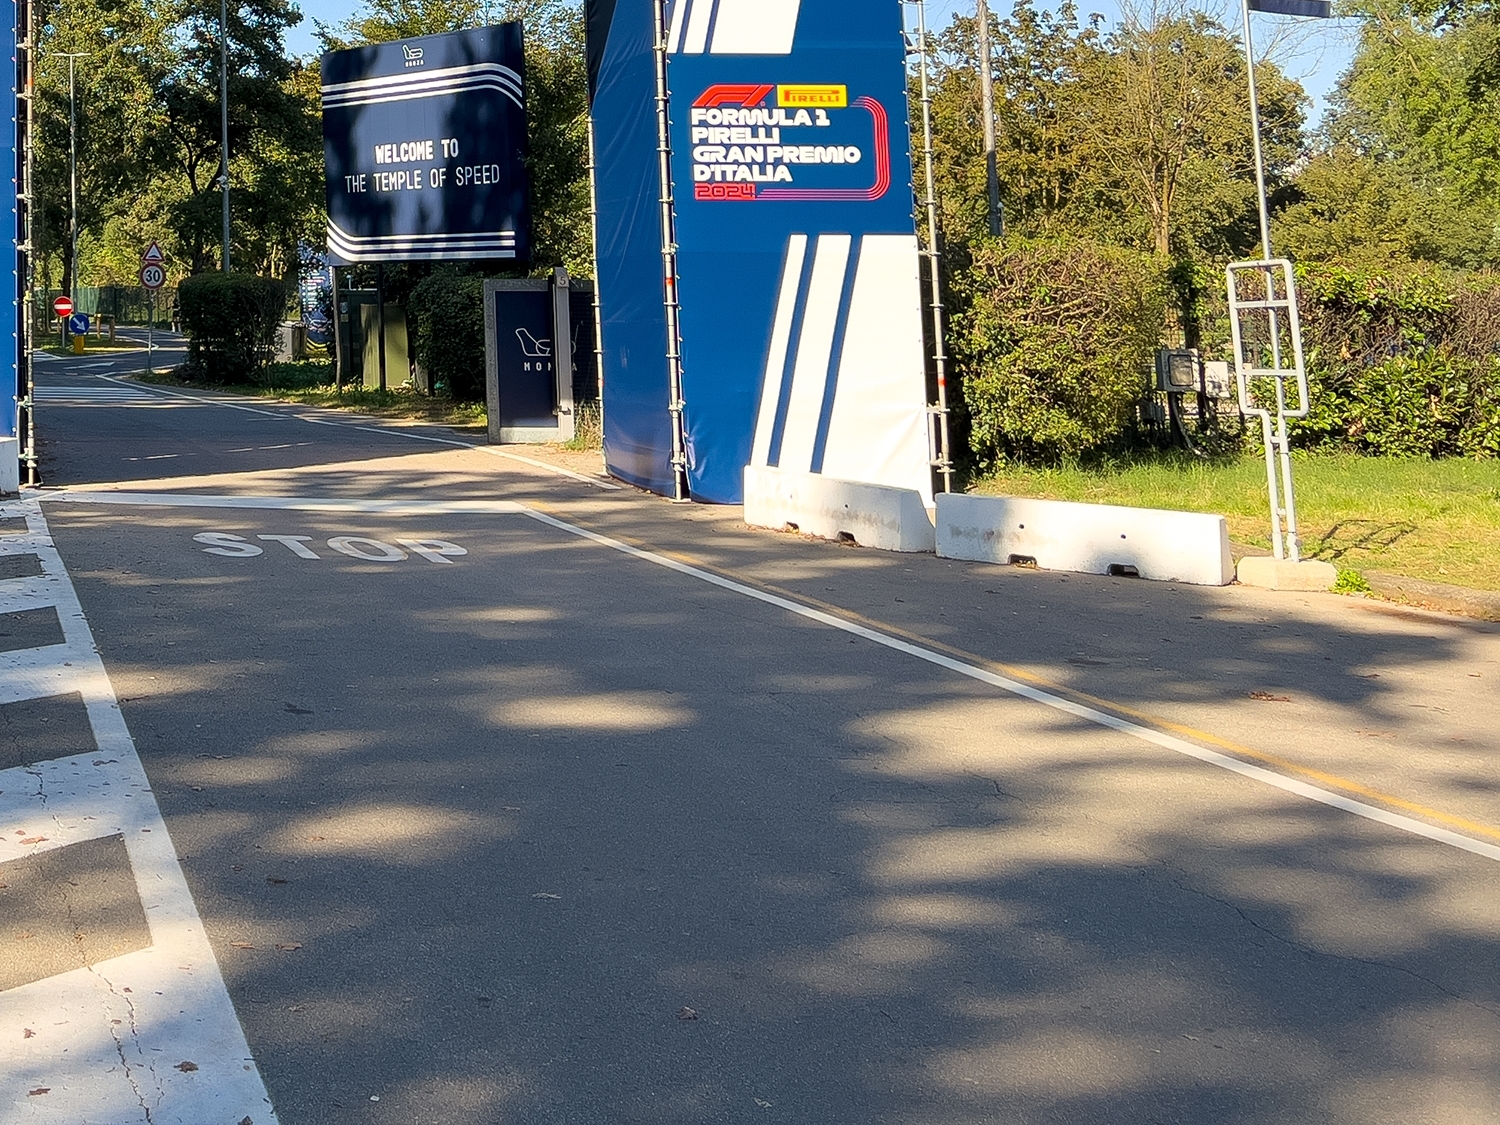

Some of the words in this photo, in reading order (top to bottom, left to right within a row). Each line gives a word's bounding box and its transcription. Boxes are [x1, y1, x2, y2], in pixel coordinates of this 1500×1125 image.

[783, 89, 840, 103] PIRELLI
[691, 108, 813, 125] FORMULA
[815, 108, 830, 126] 1
[692, 127, 780, 144] PIRELLI
[375, 140, 434, 164] WELCOME
[441, 138, 459, 158] TO
[693, 146, 765, 163] GRAN
[768, 146, 861, 163] PREMIO
[345, 173, 367, 193] THE
[373, 169, 422, 192] TEMPLE
[430, 168, 446, 188] OF
[455, 164, 500, 187] SPEED
[694, 165, 793, 181] D'ITALIA
[695, 184, 756, 200] 2024
[146, 269, 161, 283] 30
[559, 276, 566, 286] 5
[192, 531, 469, 564] STOP
